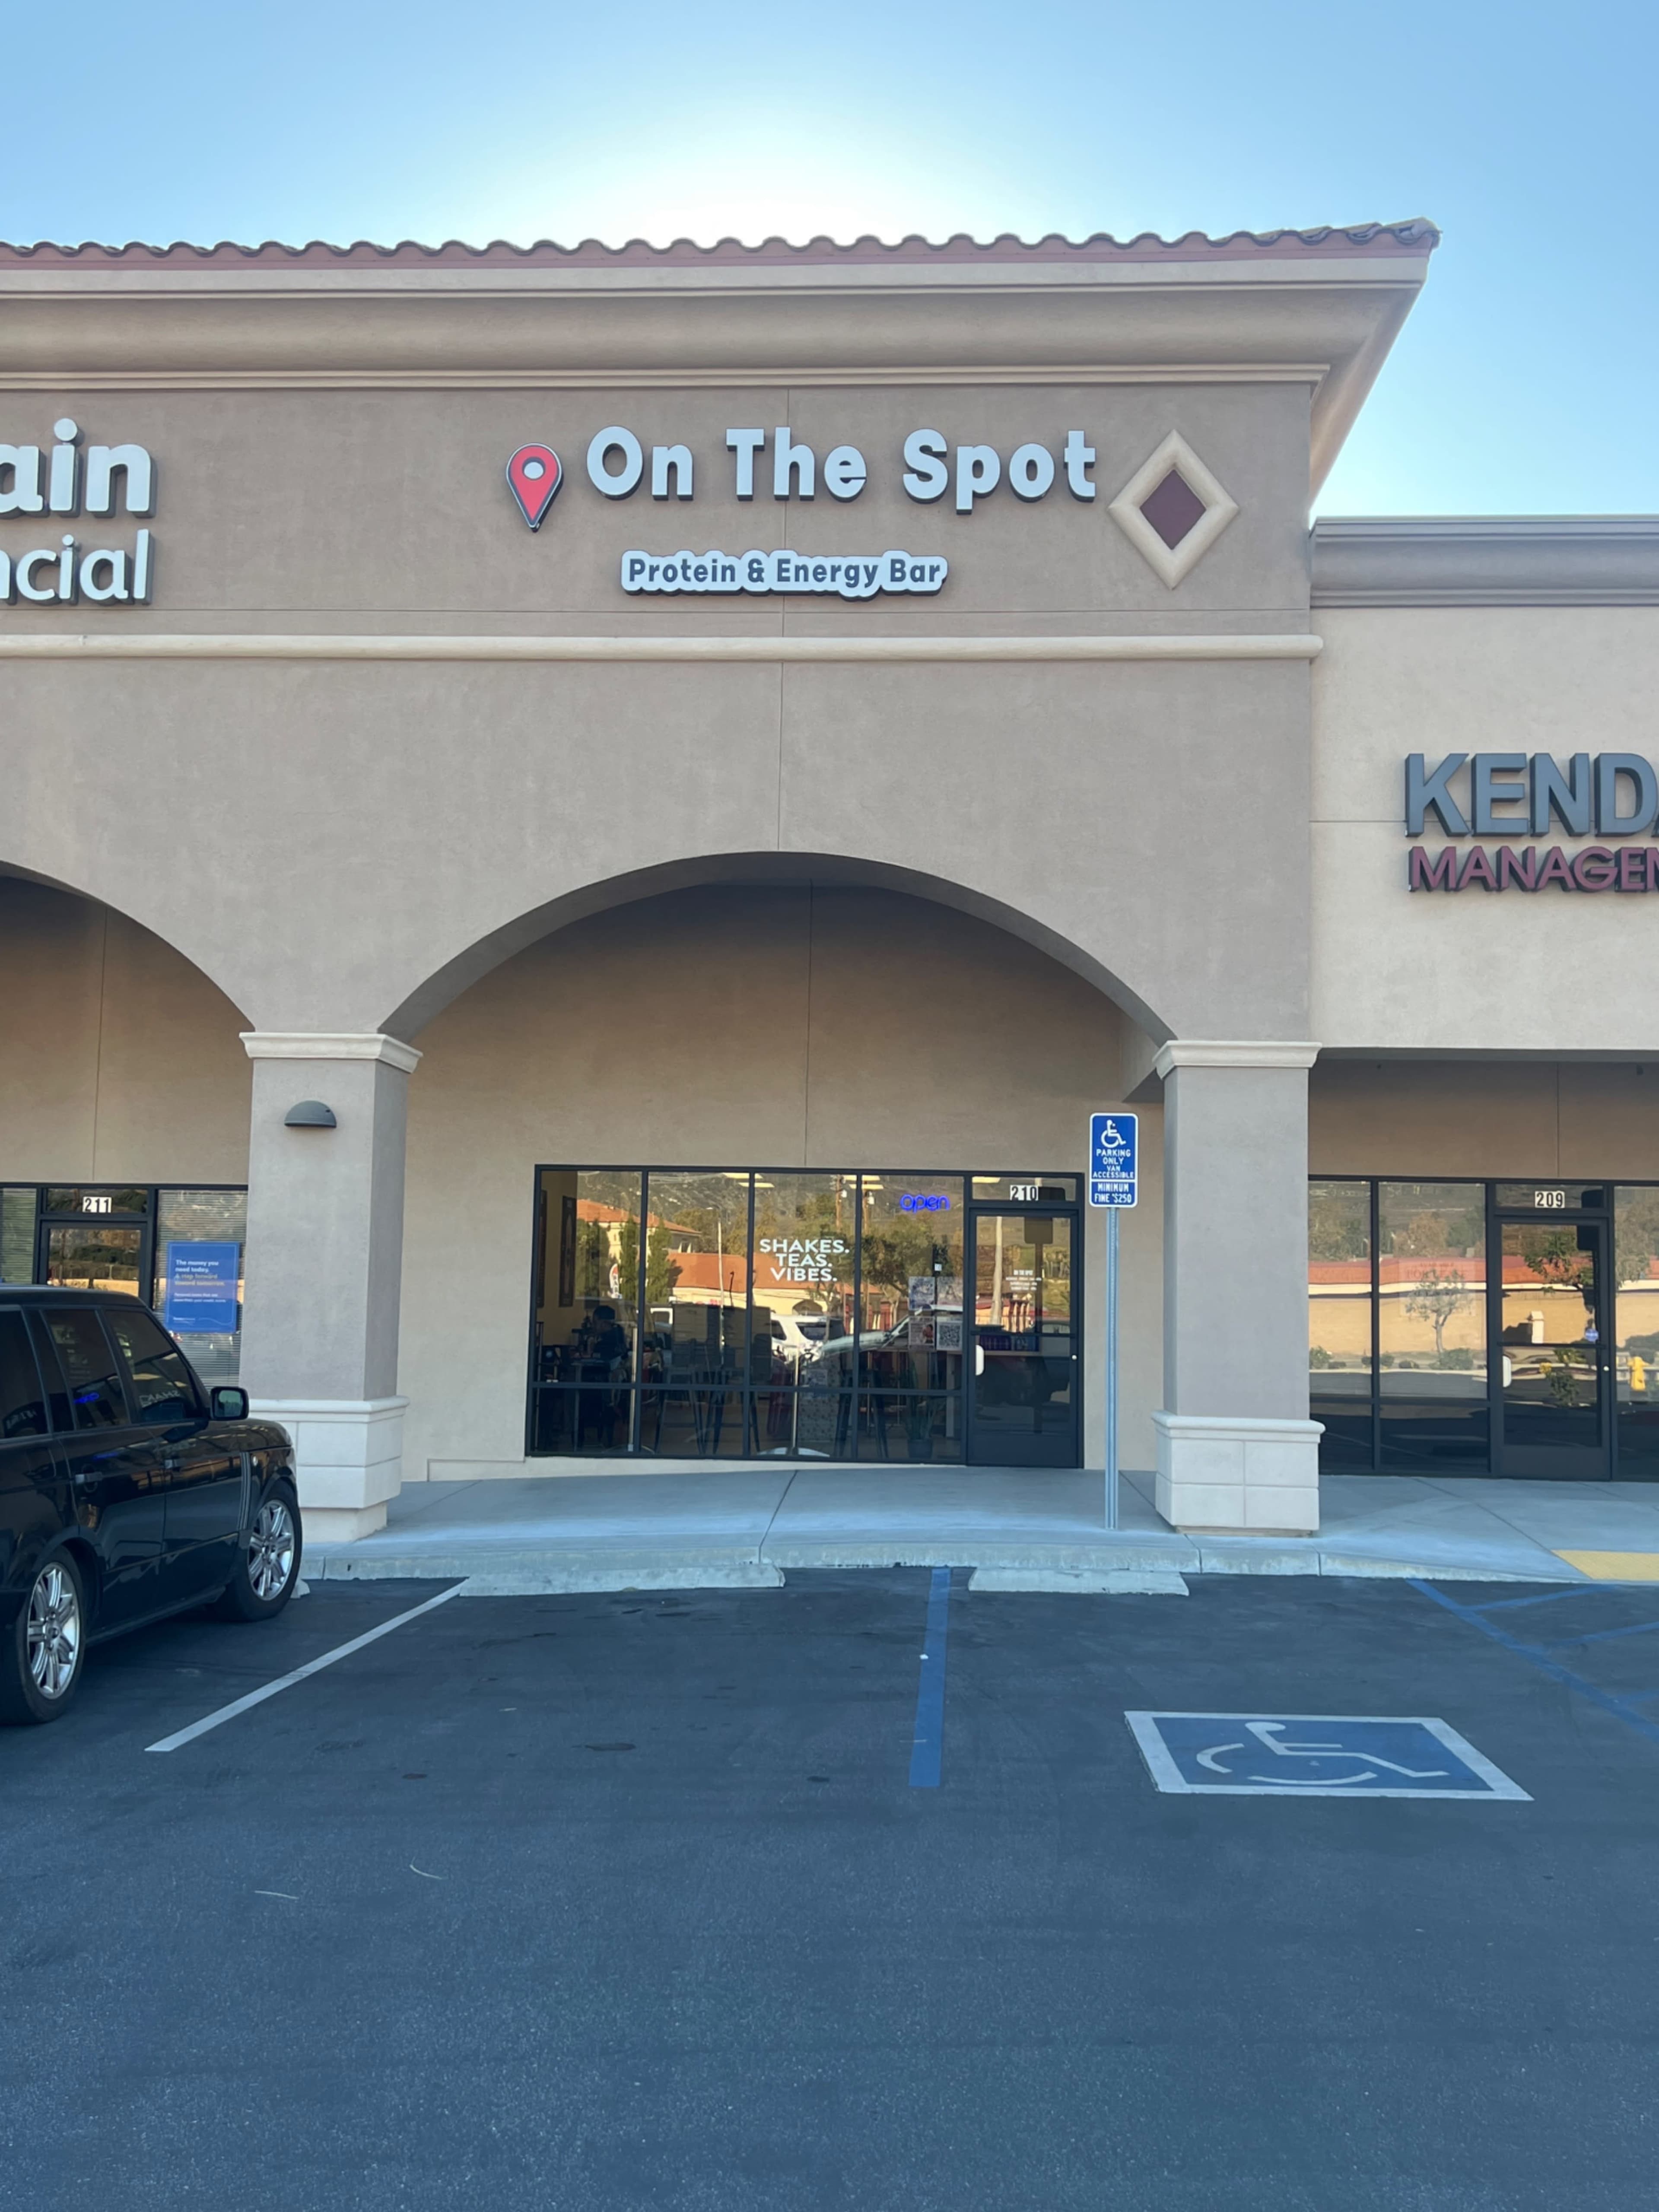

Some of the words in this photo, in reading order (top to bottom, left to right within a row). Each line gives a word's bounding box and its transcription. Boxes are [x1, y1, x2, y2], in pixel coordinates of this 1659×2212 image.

[0, 418, 156, 516] ain
[586, 426, 693, 500] On
[726, 427, 866, 502] The
[903, 428, 1096, 514] Spot
[629, 558, 735, 582] Protein
[747, 558, 764, 582] &
[778, 558, 878, 588] Energy
[890, 558, 940, 582] Bar
[1405, 753, 1659, 837] KEND
[1096, 1149, 1131, 1157] PARKING
[1011, 1186, 1037, 1201] 210
[1098, 1182, 1129, 1192] MINIMUM
[85, 1198, 109, 1213] 211
[900, 1194, 950, 1214] open
[1094, 1193, 1110, 1202] FINE
[1112, 1193, 1132, 1203] $250
[1536, 1192, 1563, 1208] 209
[760, 1239, 850, 1253] SHAKES.
[775, 1253, 833, 1267] TEAS.
[770, 1267, 837, 1281] VIBES.
